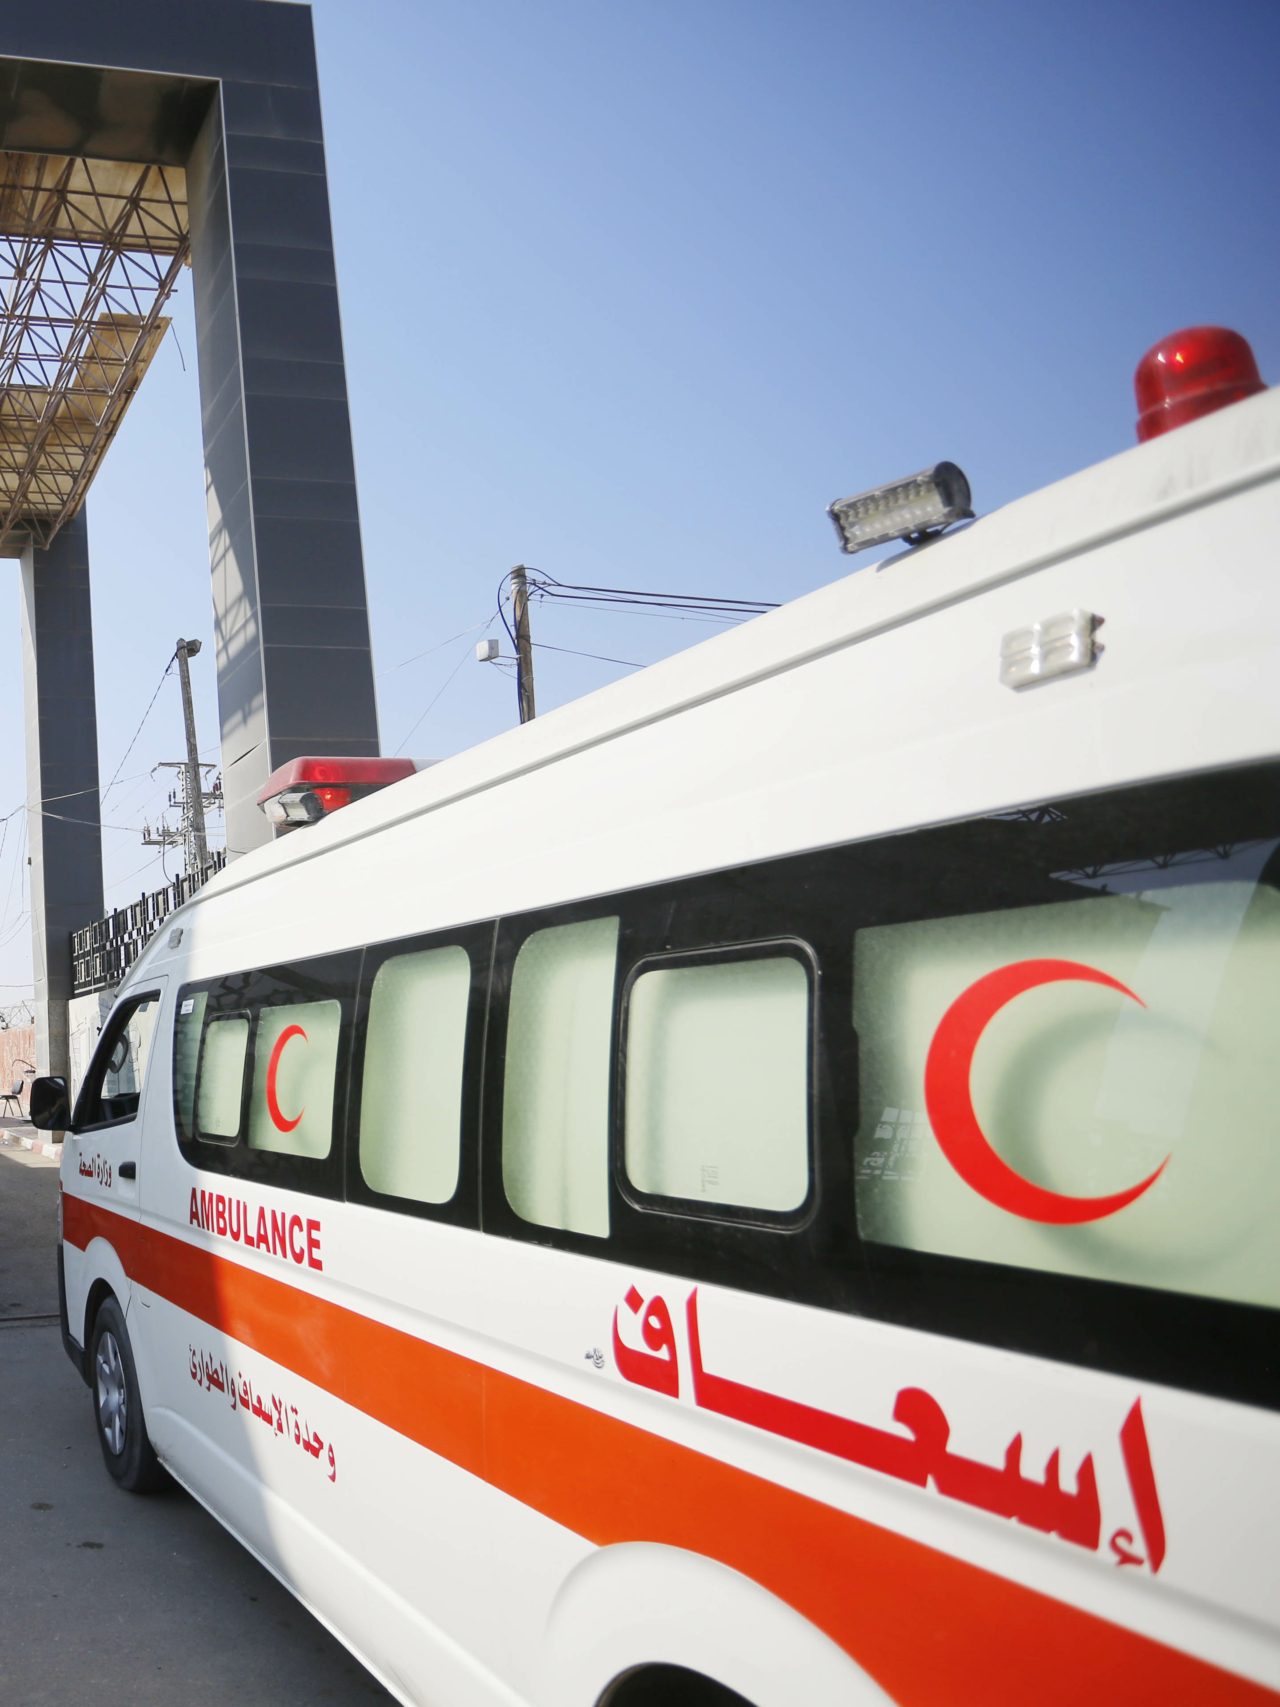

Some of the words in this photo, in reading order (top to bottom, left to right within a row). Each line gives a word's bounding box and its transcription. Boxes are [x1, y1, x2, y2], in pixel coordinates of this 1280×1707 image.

[79, 1152, 96, 1178] الصحة
[97, 1153, 112, 1188] وزارة
[189, 1186, 324, 1272] AMBULANCE
[238, 1371, 290, 1438] الإسعاف
[612, 1283, 1166, 1576] إسعاف
[291, 1404, 337, 1483] وحدة
